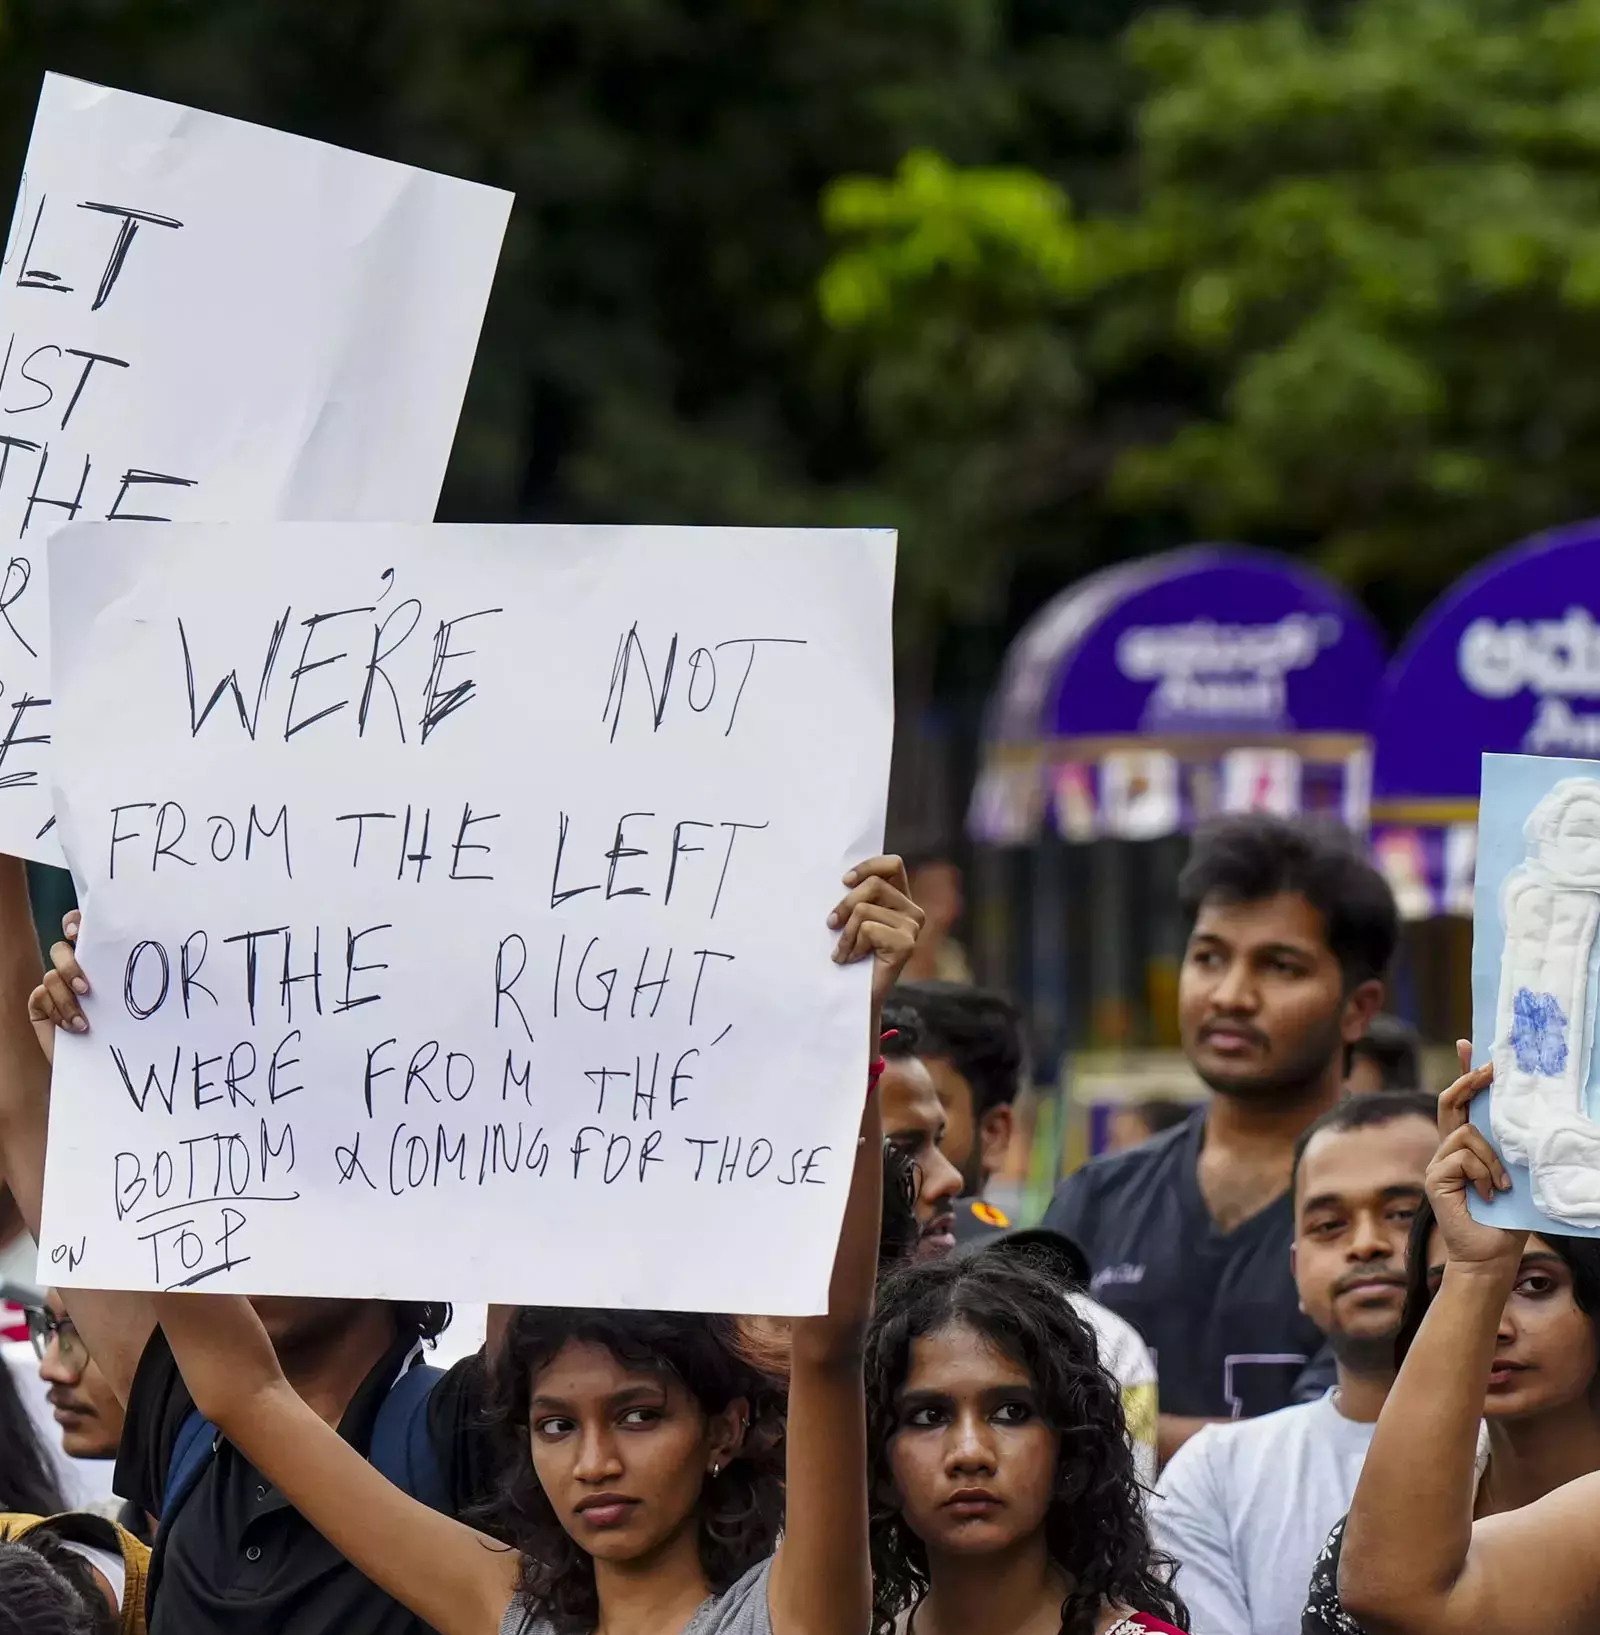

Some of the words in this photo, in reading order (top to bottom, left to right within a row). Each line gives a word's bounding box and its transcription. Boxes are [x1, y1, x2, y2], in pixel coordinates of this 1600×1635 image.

[4, 173, 184, 311] LT
[178, 567, 504, 745] WE'RE
[602, 620, 808, 744] NOT
[108, 801, 296, 880] FROM
[336, 802, 502, 883] THE
[550, 811, 769, 919] LEFT
[109, 1029, 305, 1116] WERE
[364, 1039, 534, 1113] FROM
[584, 1048, 700, 1122] THE
[113, 1119, 298, 1221] BOTTOM
[569, 1126, 665, 1185] FOR
[683, 1135, 830, 1186] THOSE
[50, 1234, 88, 1272] ON
[138, 1206, 250, 1284] TOP
